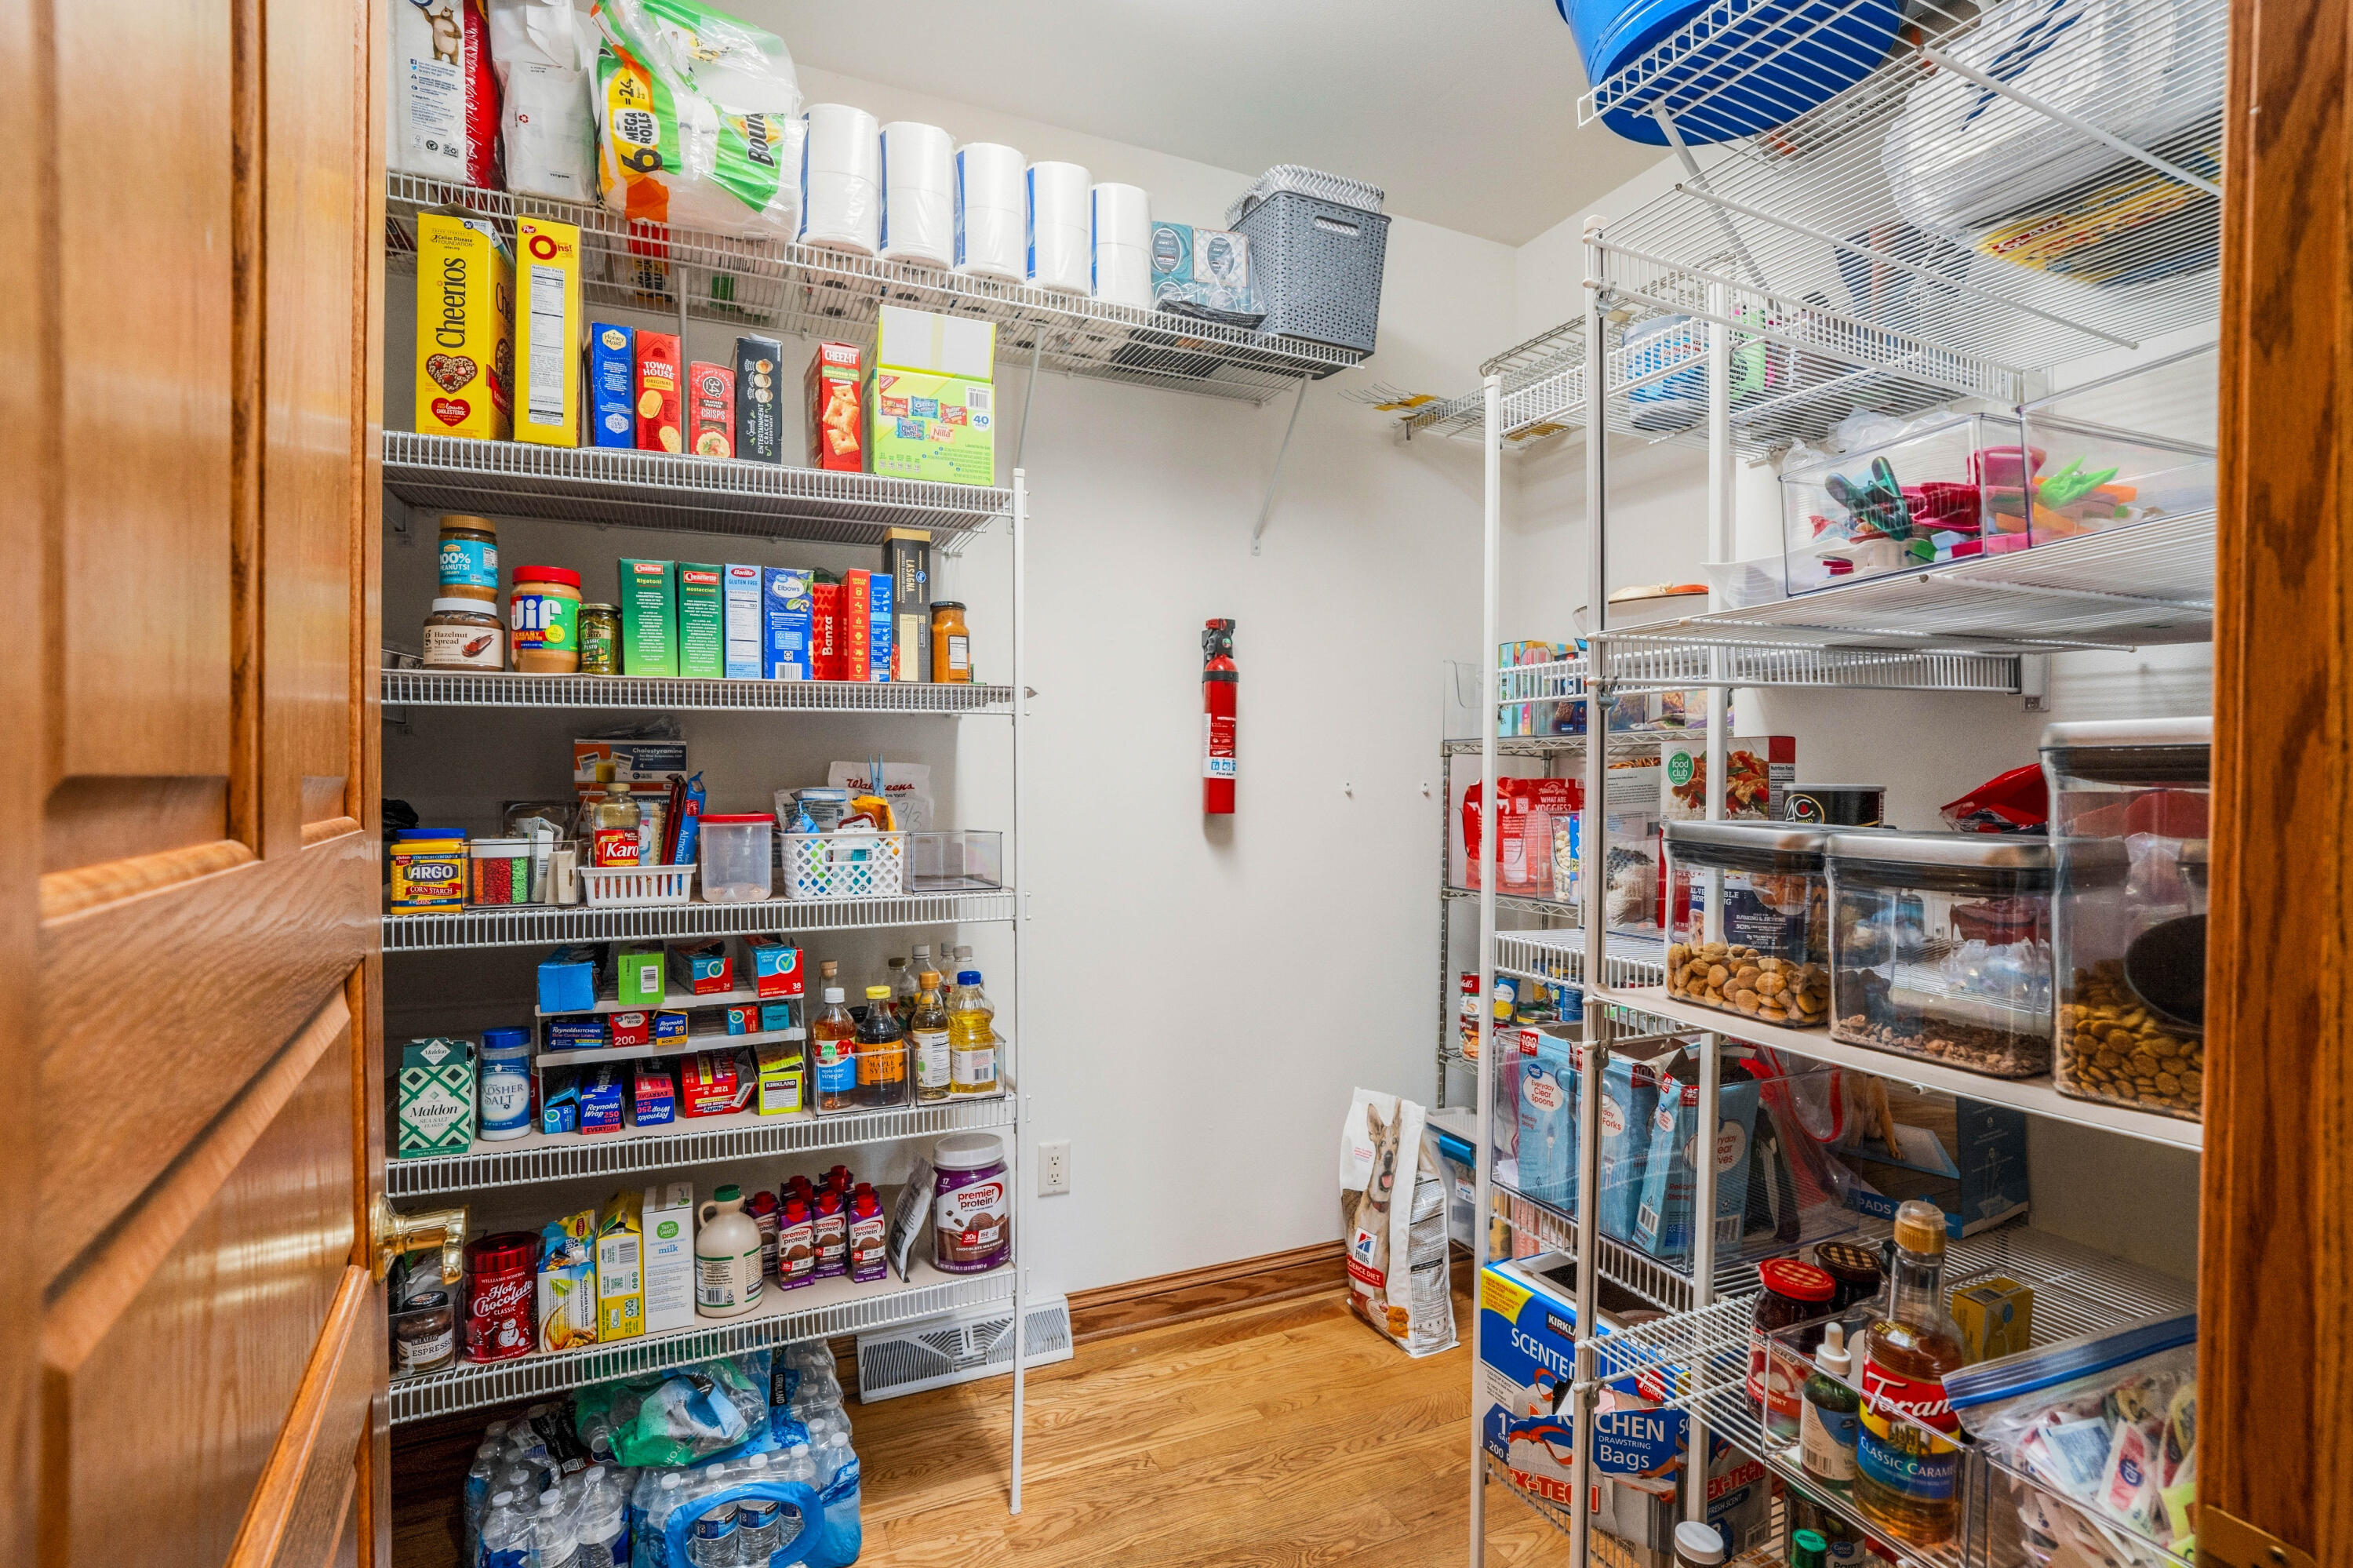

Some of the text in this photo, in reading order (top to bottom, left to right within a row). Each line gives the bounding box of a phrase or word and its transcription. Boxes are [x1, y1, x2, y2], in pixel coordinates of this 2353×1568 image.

[620, 111, 663, 173] 6 MEGA ROLLS
[436, 258, 467, 348] Cheerios
[605, 333, 624, 343] Honey
[643, 362, 674, 373] TOWN
[643, 369, 675, 380] HOUSE
[701, 409, 726, 420] CRISPS
[973, 415, 989, 424] 40
[933, 428, 951, 438] Nilla
[439, 552, 471, 565] 100%
[906, 559, 915, 592] LASAGNA
[511, 598, 562, 631] Jif
[435, 638, 460, 646] Spread
[822, 616, 833, 656] Banza
[1671, 759, 1689, 769] food
[1672, 767, 1688, 777] club
[846, 778, 915, 791] Waleens
[606, 842, 639, 857] Karo
[675, 829, 689, 863] Almond
[409, 865, 453, 879] ARGO
[428, 886, 453, 895] STARCH
[614, 1035, 636, 1046] 200
[482, 1083, 525, 1095] KOSHER
[1531, 1079, 1555, 1093] Everyday
[1533, 1087, 1551, 1098] Clear
[484, 1094, 515, 1105] SALT
[1531, 1093, 1555, 1108] Spoons
[409, 1104, 458, 1119] Maldon
[587, 1102, 620, 1111] Reynolds
[584, 1110, 604, 1119] Wrap
[637, 1111, 668, 1122] Reynolds
[1602, 1118, 1622, 1130] Forks
[1717, 1134, 1737, 1147] ryday
[958, 1188, 995, 1202] premier
[961, 1197, 993, 1210] protein
[1857, 1194, 1891, 1215] PADS
[576, 1218, 585, 1236] LIPTON
[816, 1221, 840, 1229] premier
[853, 1224, 878, 1233] premier
[781, 1229, 809, 1240] premier
[784, 1235, 808, 1245] protein
[855, 1229, 878, 1238] protein
[658, 1244, 678, 1254] milk
[1355, 1249, 1370, 1265] Hill's
[506, 1271, 526, 1280] SONOMA
[1347, 1259, 1380, 1282] SCIENCE DIET
[489, 1280, 516, 1299] Hot
[473, 1280, 533, 1318] Chocolate
[493, 1306, 516, 1315] CLASSIC
[412, 1338, 452, 1357] ESPRESSO
[1866, 1370, 1952, 1418] Toran
[1489, 1440, 1504, 1458] 200
[1598, 1435, 1651, 1450] DRAWSTRING
[1599, 1444, 1650, 1471] Bags
[1860, 1435, 1903, 1472] CLASSIC
[1707, 1459, 1765, 1502] EX-TECH
[1708, 1493, 1743, 1515] FRESH SCENT
